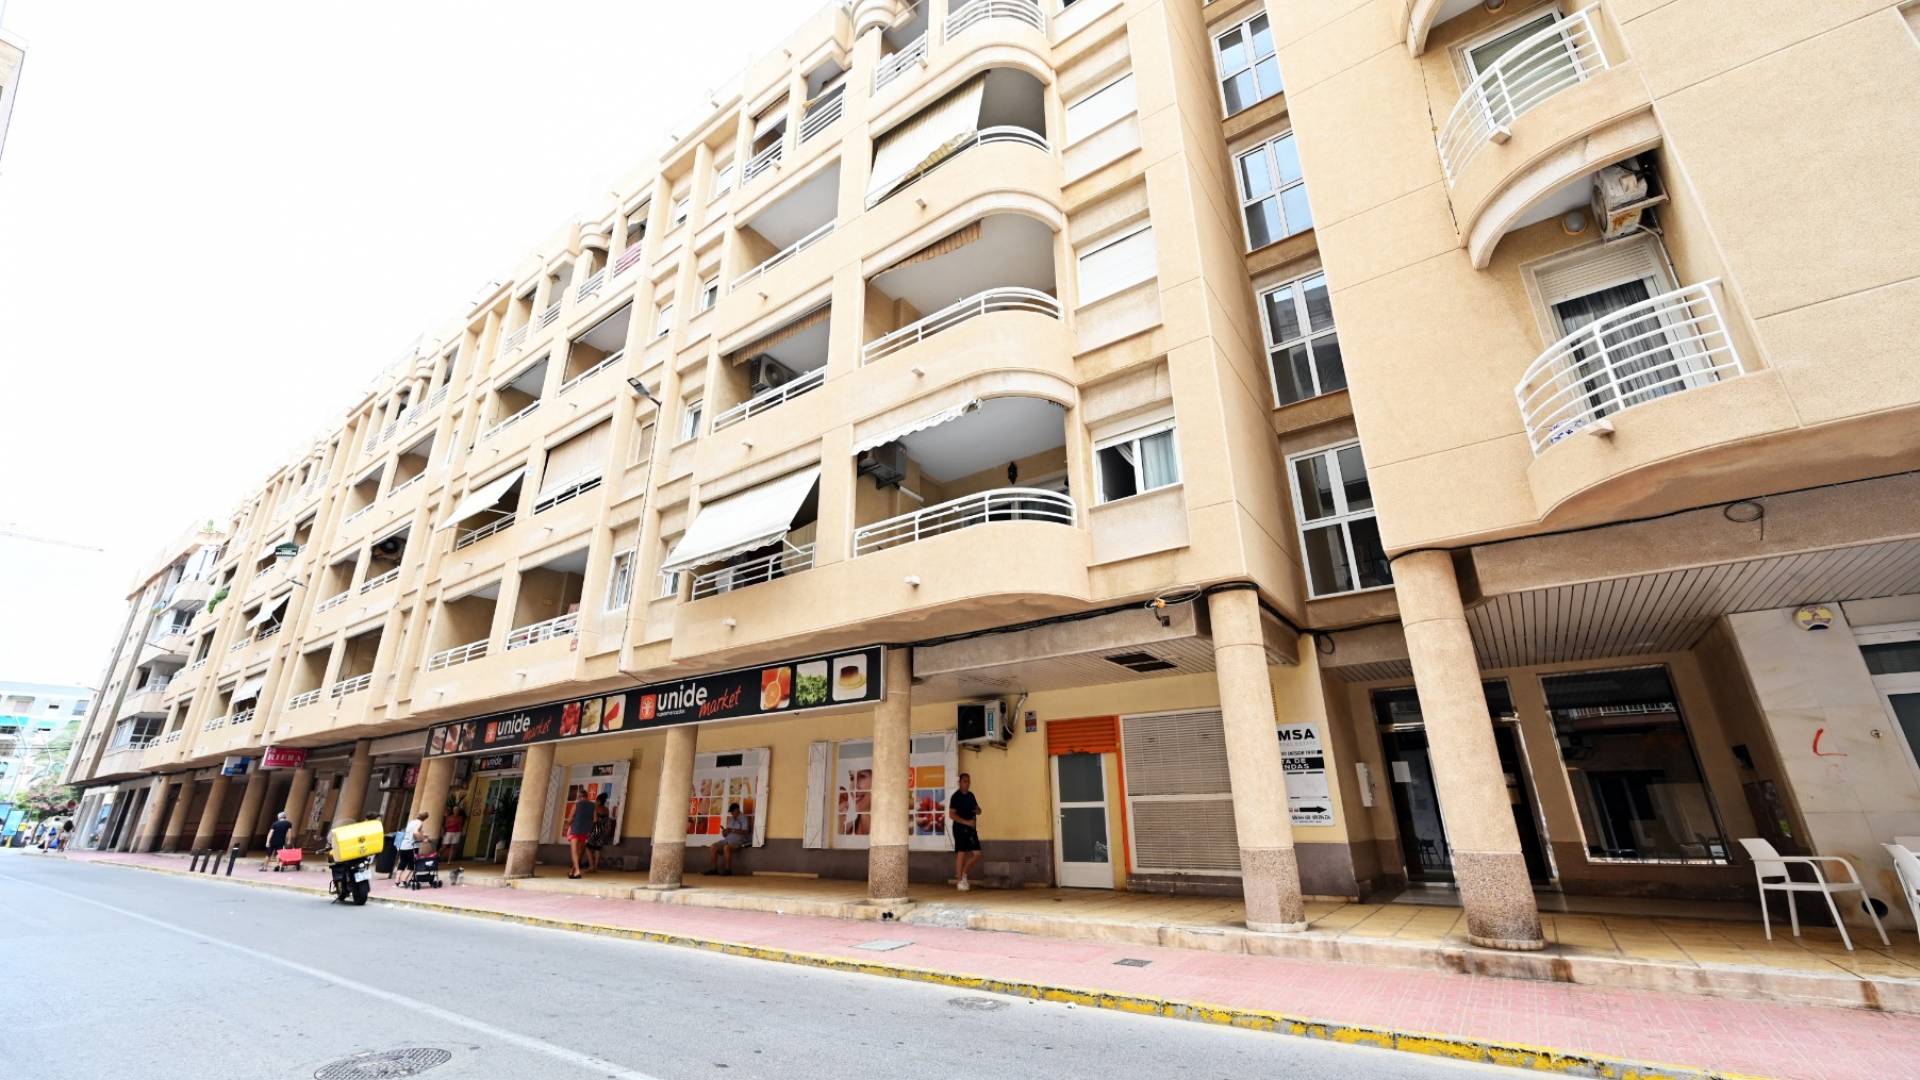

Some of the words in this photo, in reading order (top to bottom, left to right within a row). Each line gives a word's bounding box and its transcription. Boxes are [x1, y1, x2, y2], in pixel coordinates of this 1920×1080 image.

[657, 682, 708, 711] unide
[698, 685, 742, 718] market
[497, 713, 531, 735] unide
[1277, 728, 1315, 741] MSA
